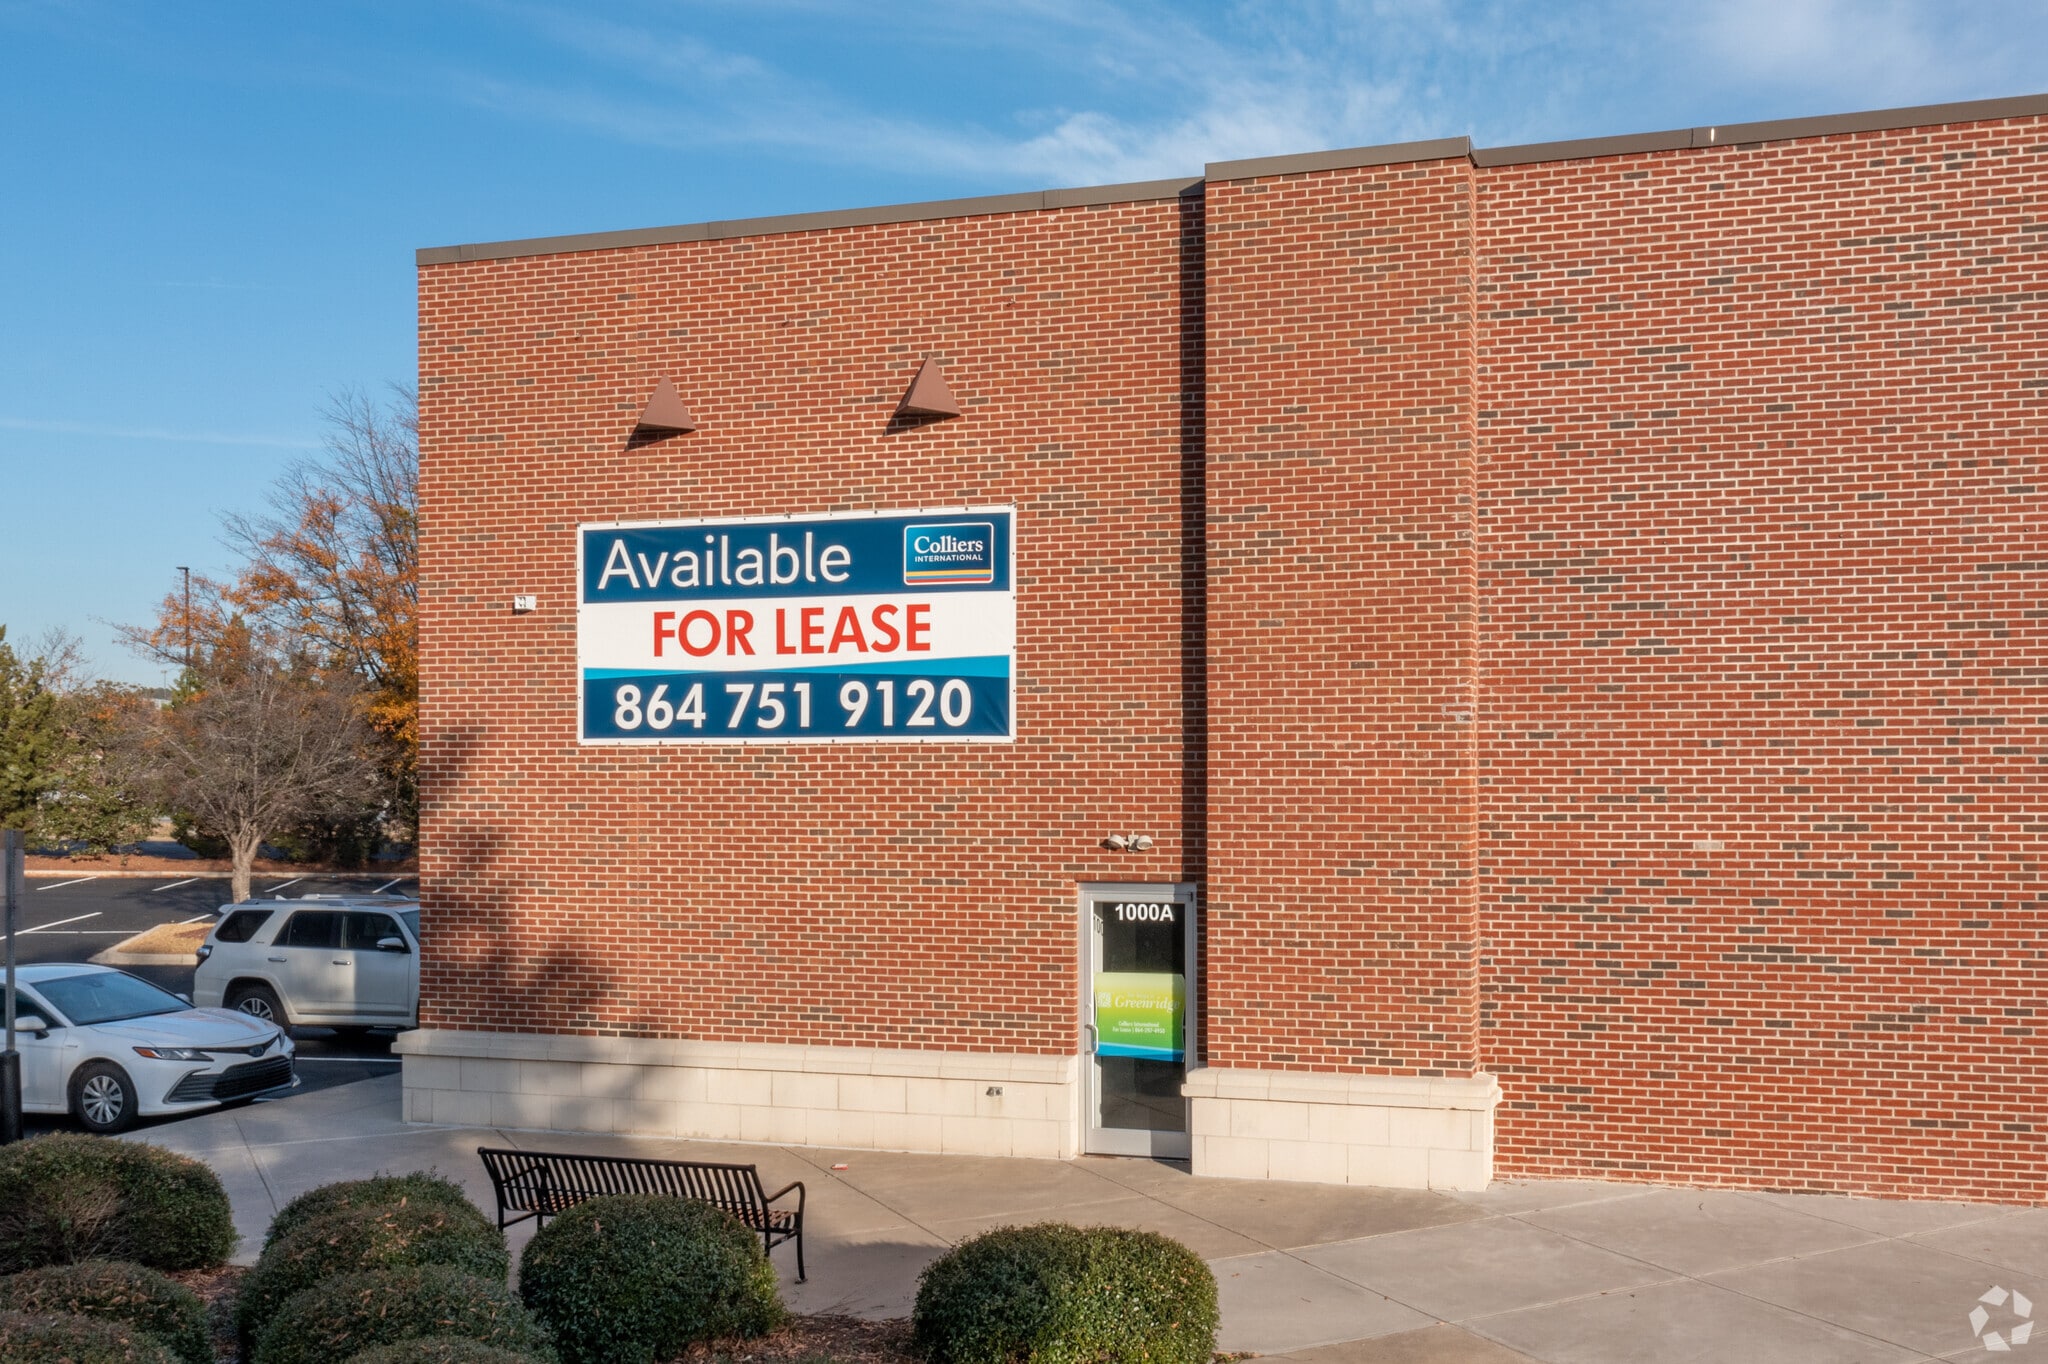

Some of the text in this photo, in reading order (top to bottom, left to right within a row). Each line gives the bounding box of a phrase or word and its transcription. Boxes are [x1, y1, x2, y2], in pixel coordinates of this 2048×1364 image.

[914, 534, 984, 554] Colliers
[598, 531, 851, 590] Available
[914, 553, 983, 563] INTERNATIONAL
[653, 603, 931, 657] FOR LEASE
[614, 678, 973, 730] 864 751 9120
[1115, 903, 1174, 922] 1000A
[1115, 995, 1180, 1013] Greenridge
